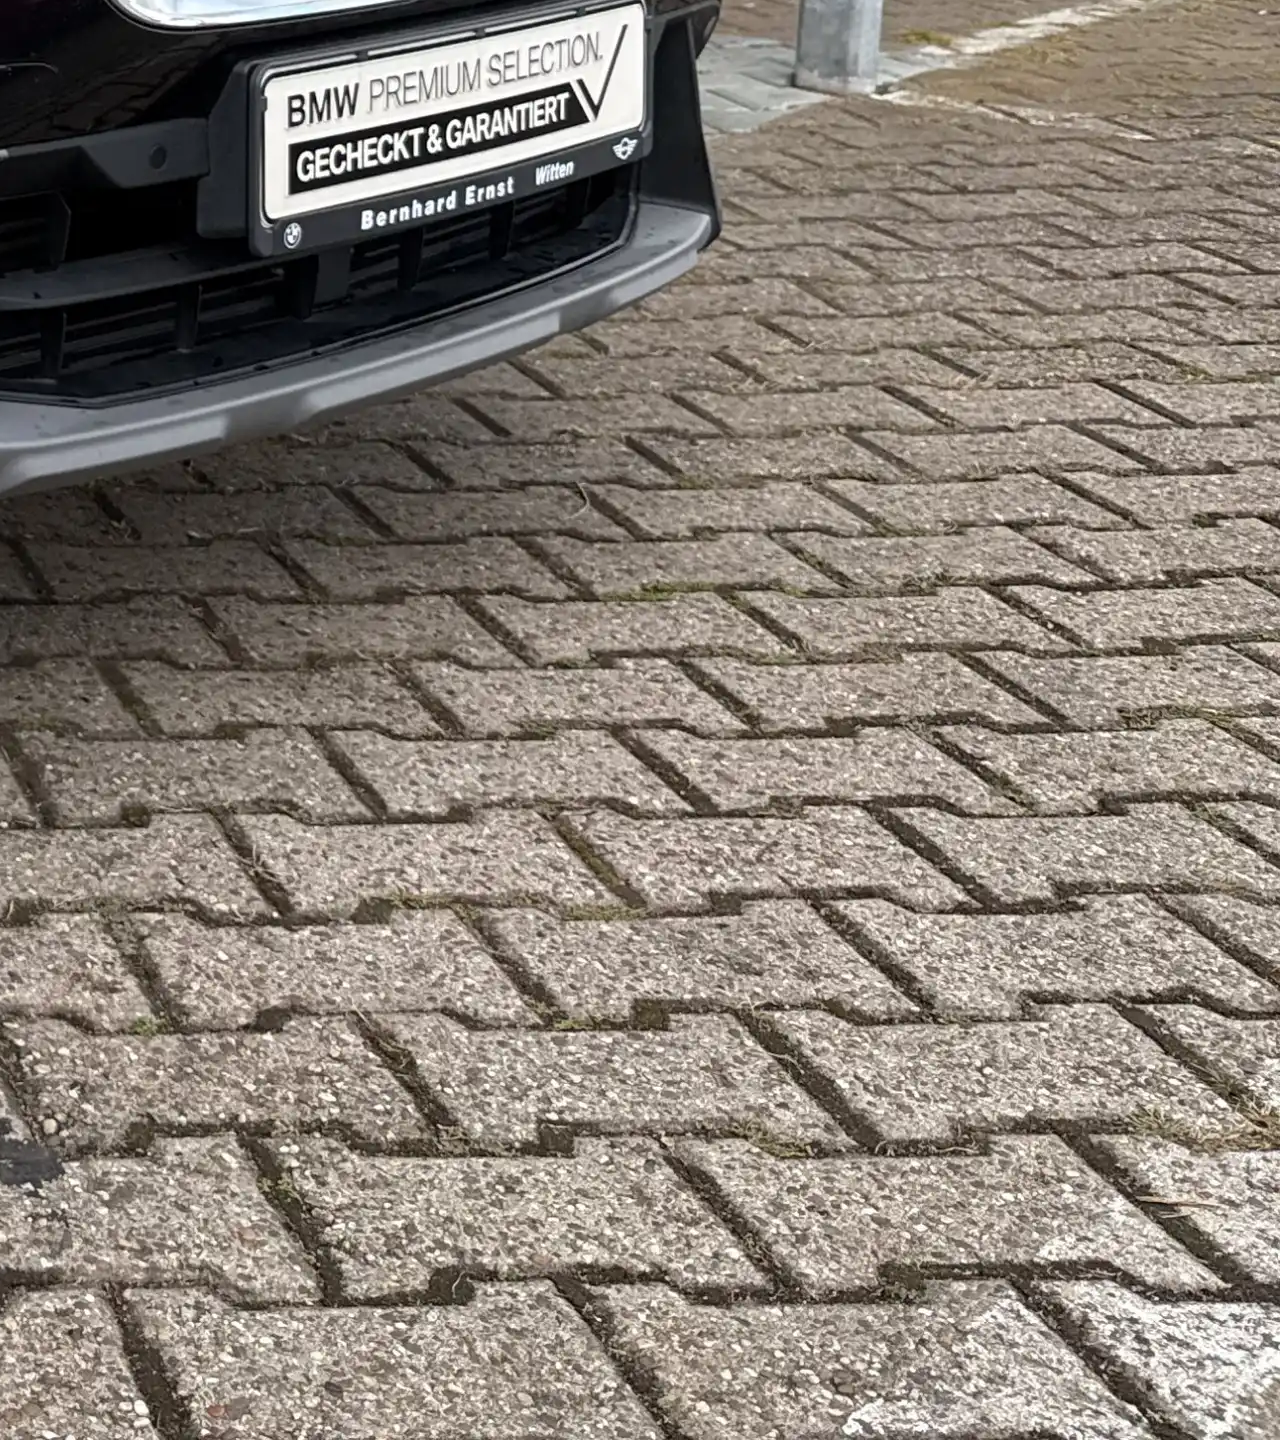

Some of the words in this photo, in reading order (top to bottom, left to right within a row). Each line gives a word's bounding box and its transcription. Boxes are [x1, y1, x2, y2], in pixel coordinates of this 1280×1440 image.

[287, 82, 360, 129] BMW
[368, 56, 482, 112] PREMIUM
[296, 127, 425, 183] GECHECKT
[426, 123, 443, 154] &
[445, 92, 570, 152] GARANTIERT
[361, 190, 457, 231] Bernhard
[464, 176, 515, 207] Ernst
[535, 159, 575, 186] Witten
